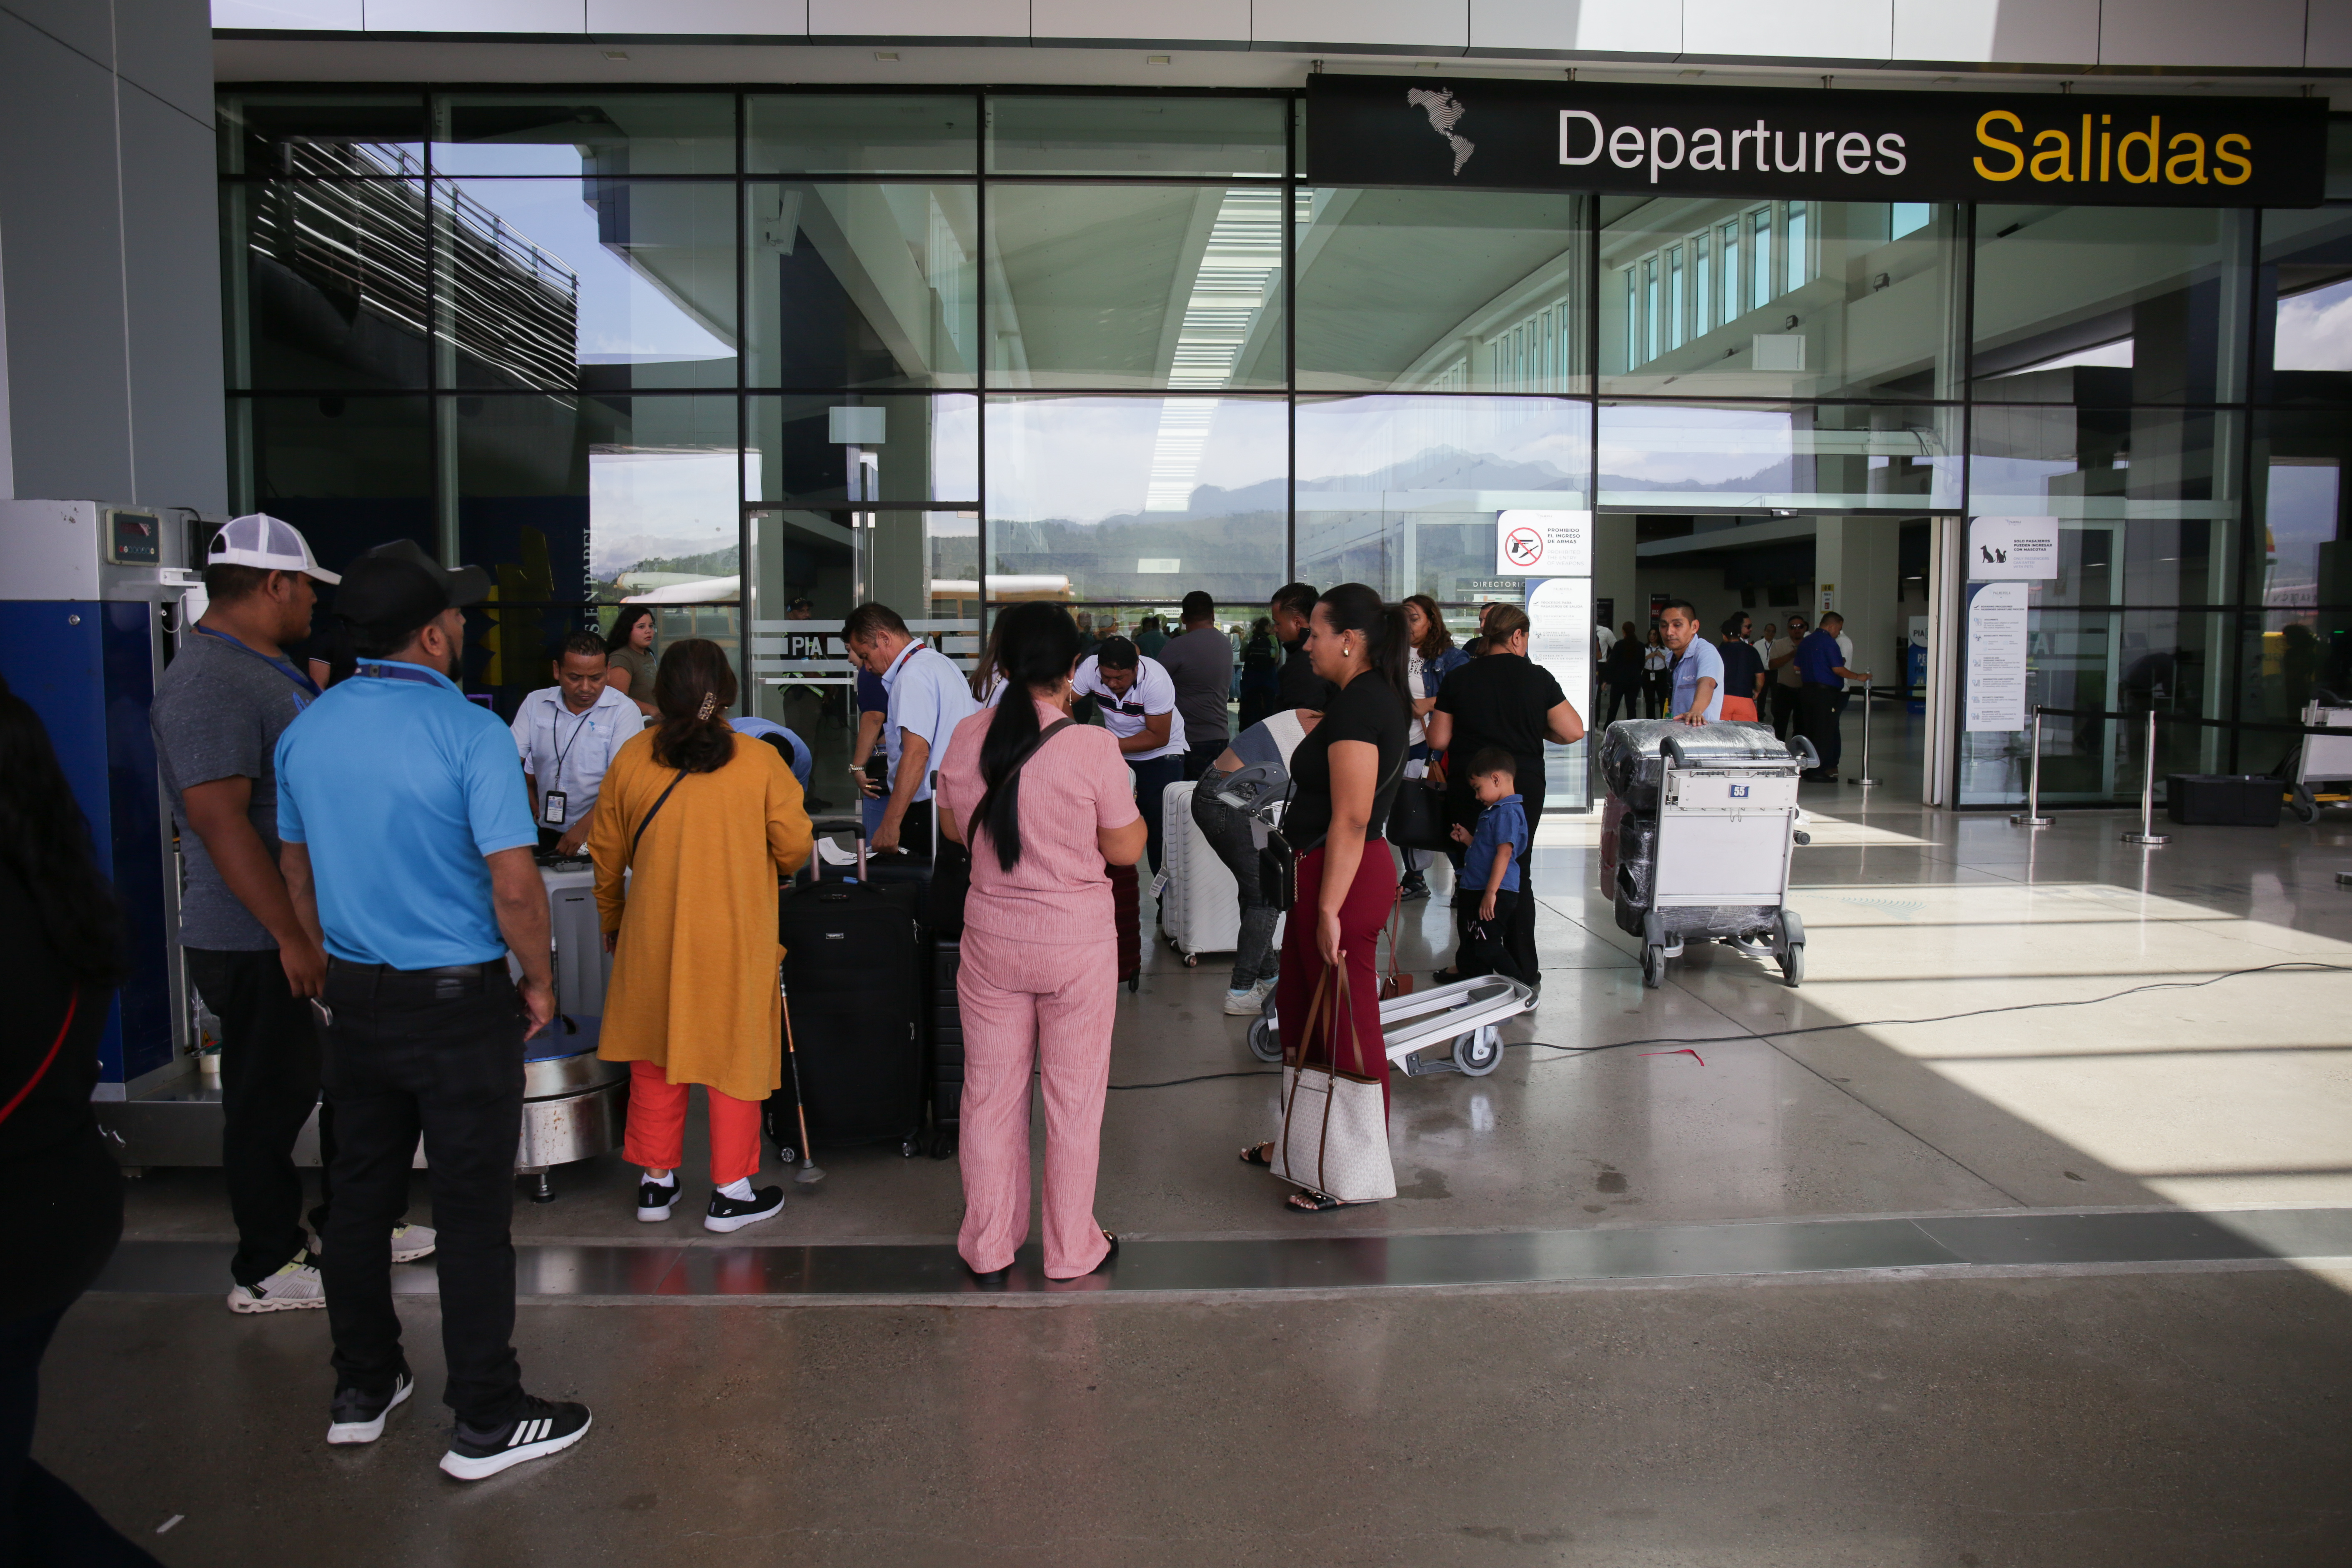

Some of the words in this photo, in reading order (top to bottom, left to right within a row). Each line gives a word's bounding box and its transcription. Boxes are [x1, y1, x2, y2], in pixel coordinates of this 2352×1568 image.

[1560, 110, 1906, 183] Departures
[1974, 110, 2252, 185] Salidas
[792, 636, 822, 655] PIA
[1918, 654, 1927, 663] PE
[1733, 787, 1745, 796] 55
